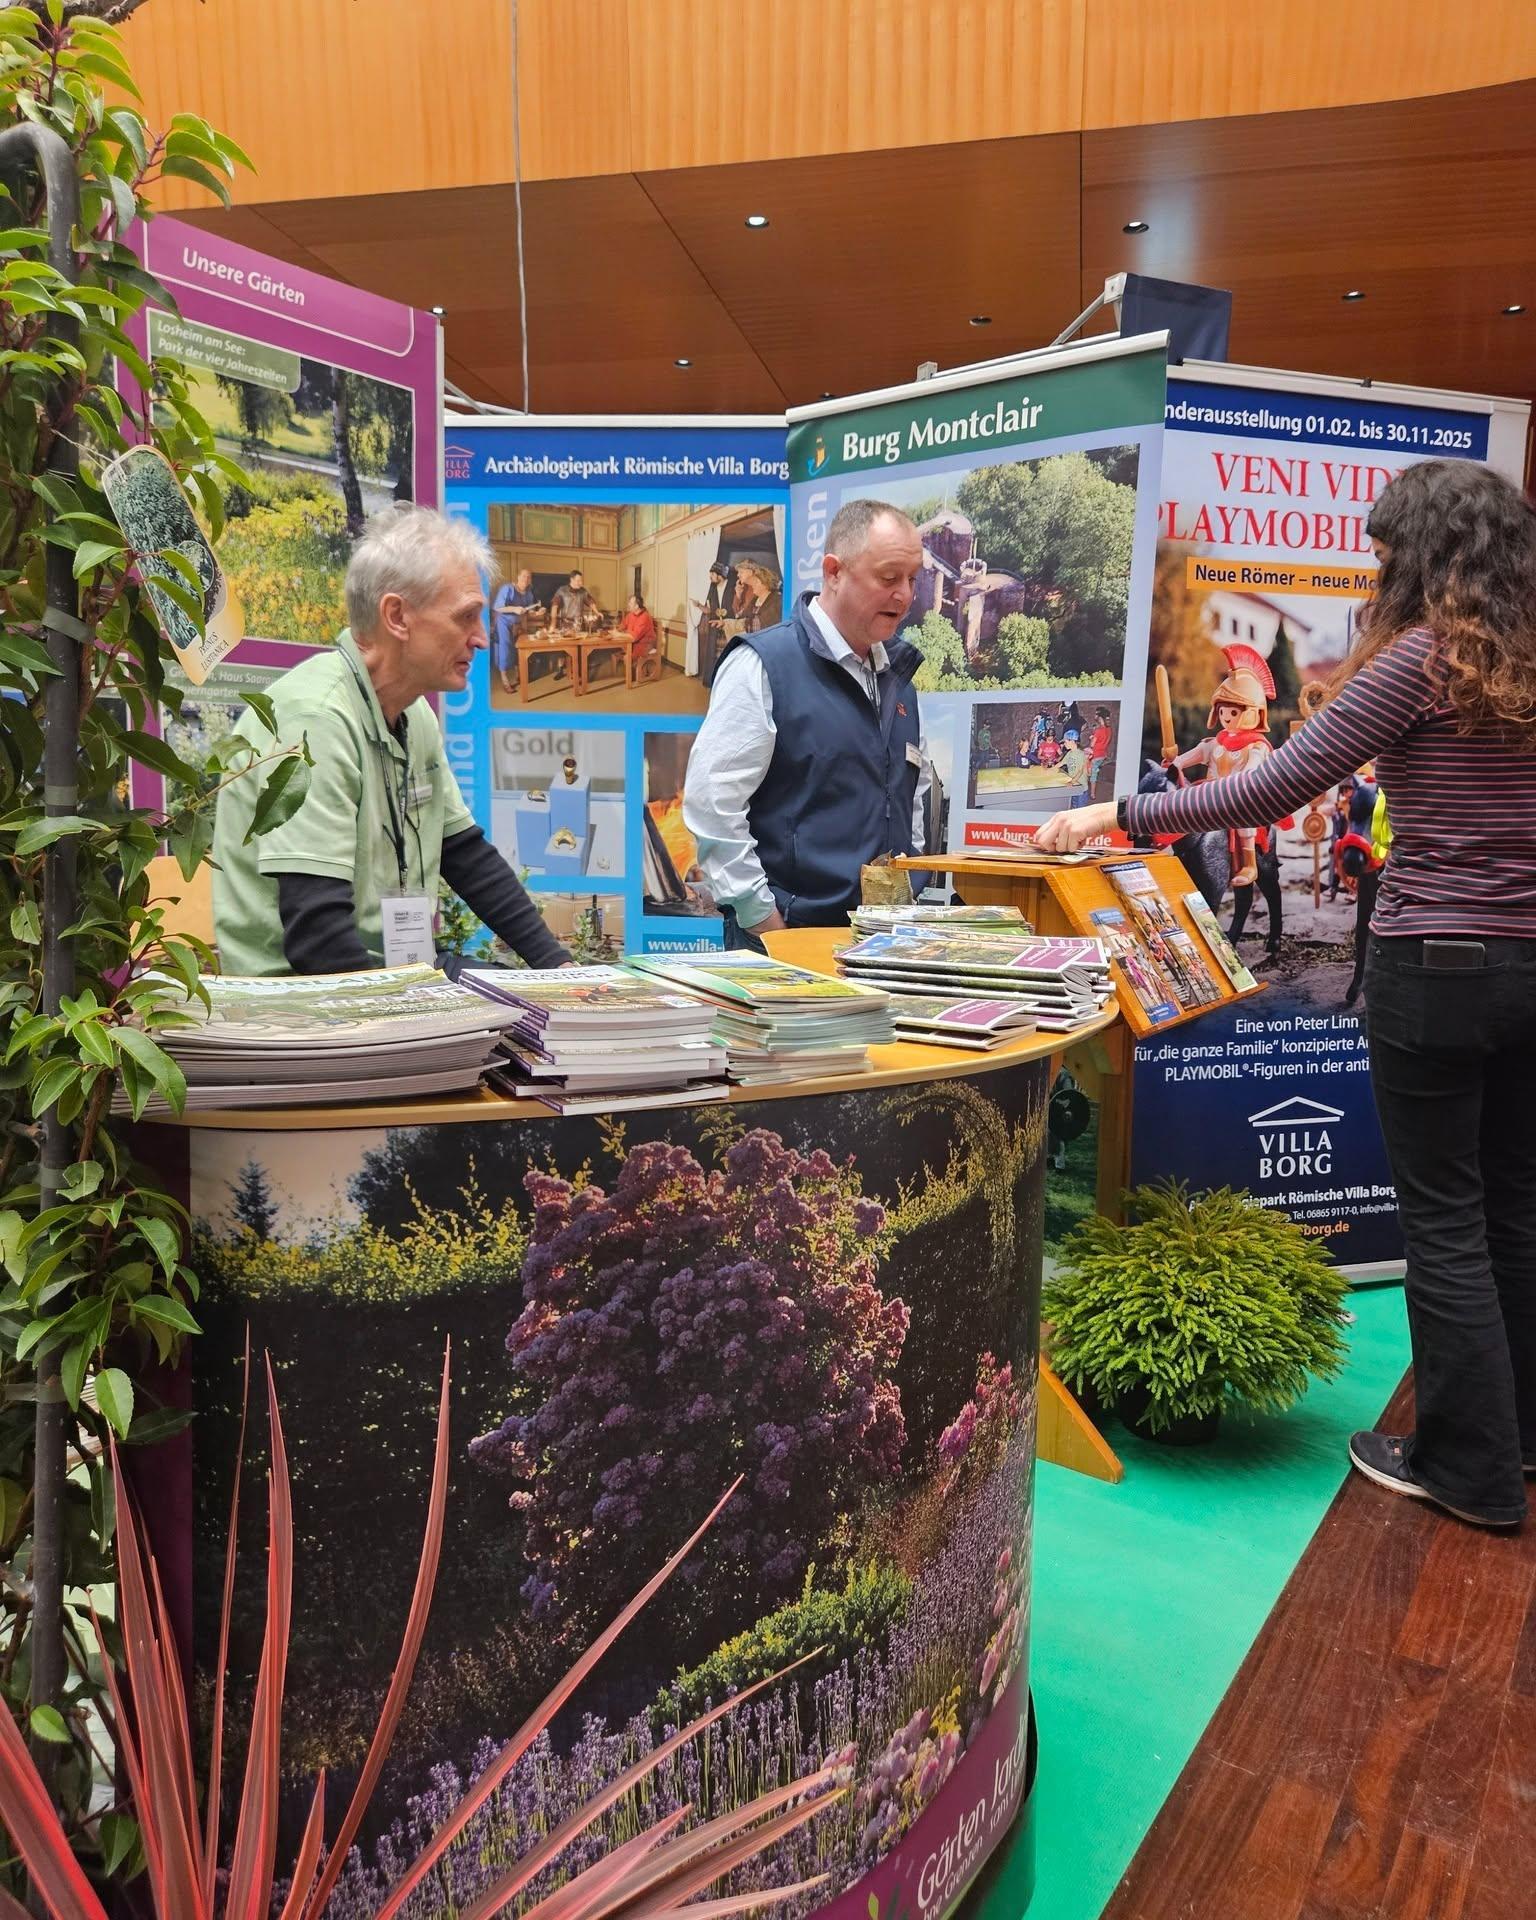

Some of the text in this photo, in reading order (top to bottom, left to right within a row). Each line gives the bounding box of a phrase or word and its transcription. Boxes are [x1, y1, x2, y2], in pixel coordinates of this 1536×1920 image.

[182, 247, 305, 306] Unsere Gärten
[158, 320, 246, 356] Losheim am See:
[158, 337, 288, 385] Park der vier Jahreszeiten
[842, 396, 1044, 463] Burg Montclair
[1305, 415, 1356, 437] 01.02.
[1359, 420, 1384, 440] bis
[1386, 423, 1472, 449] 30.11.2025
[484, 455, 790, 480] Archäologiepark Römische Villa Borg
[1211, 452, 1405, 503] VENI VID
[1158, 500, 1372, 554] LAYMOBIL
[1195, 563, 1237, 583] Neue
[1241, 567, 1295, 586] Römer
[1311, 574, 1350, 588] neue
[219, 671, 243, 683] Haus
[503, 730, 574, 755] Gold
[648, 938, 725, 953] www.villa-
[1236, 1014, 1359, 1033] Eine von Peter Linn
[1134, 1047, 1152, 1062] für
[1182, 1047, 1224, 1062] ganze
[1226, 1040, 1279, 1056] Familie“
[1282, 1037, 1354, 1056] konzipierte
[1306, 1060, 1320, 1075] in
[1322, 1058, 1344, 1073] der
[1259, 1130, 1333, 1155] VILLA
[1259, 1153, 1333, 1179] BORG
[1289, 1191, 1344, 1205] Römische
[1345, 1186, 1370, 1200] Villa
[1293, 1210, 1306, 1220] Tel.
[1306, 1208, 1330, 1218] 06865
[1331, 1205, 1359, 1216] 9117-0,
[1360, 1202, 1399, 1214] info@villa-
[1300, 1220, 1350, 1237] borg.de
[917, 1798, 986, 1910] Gärten
